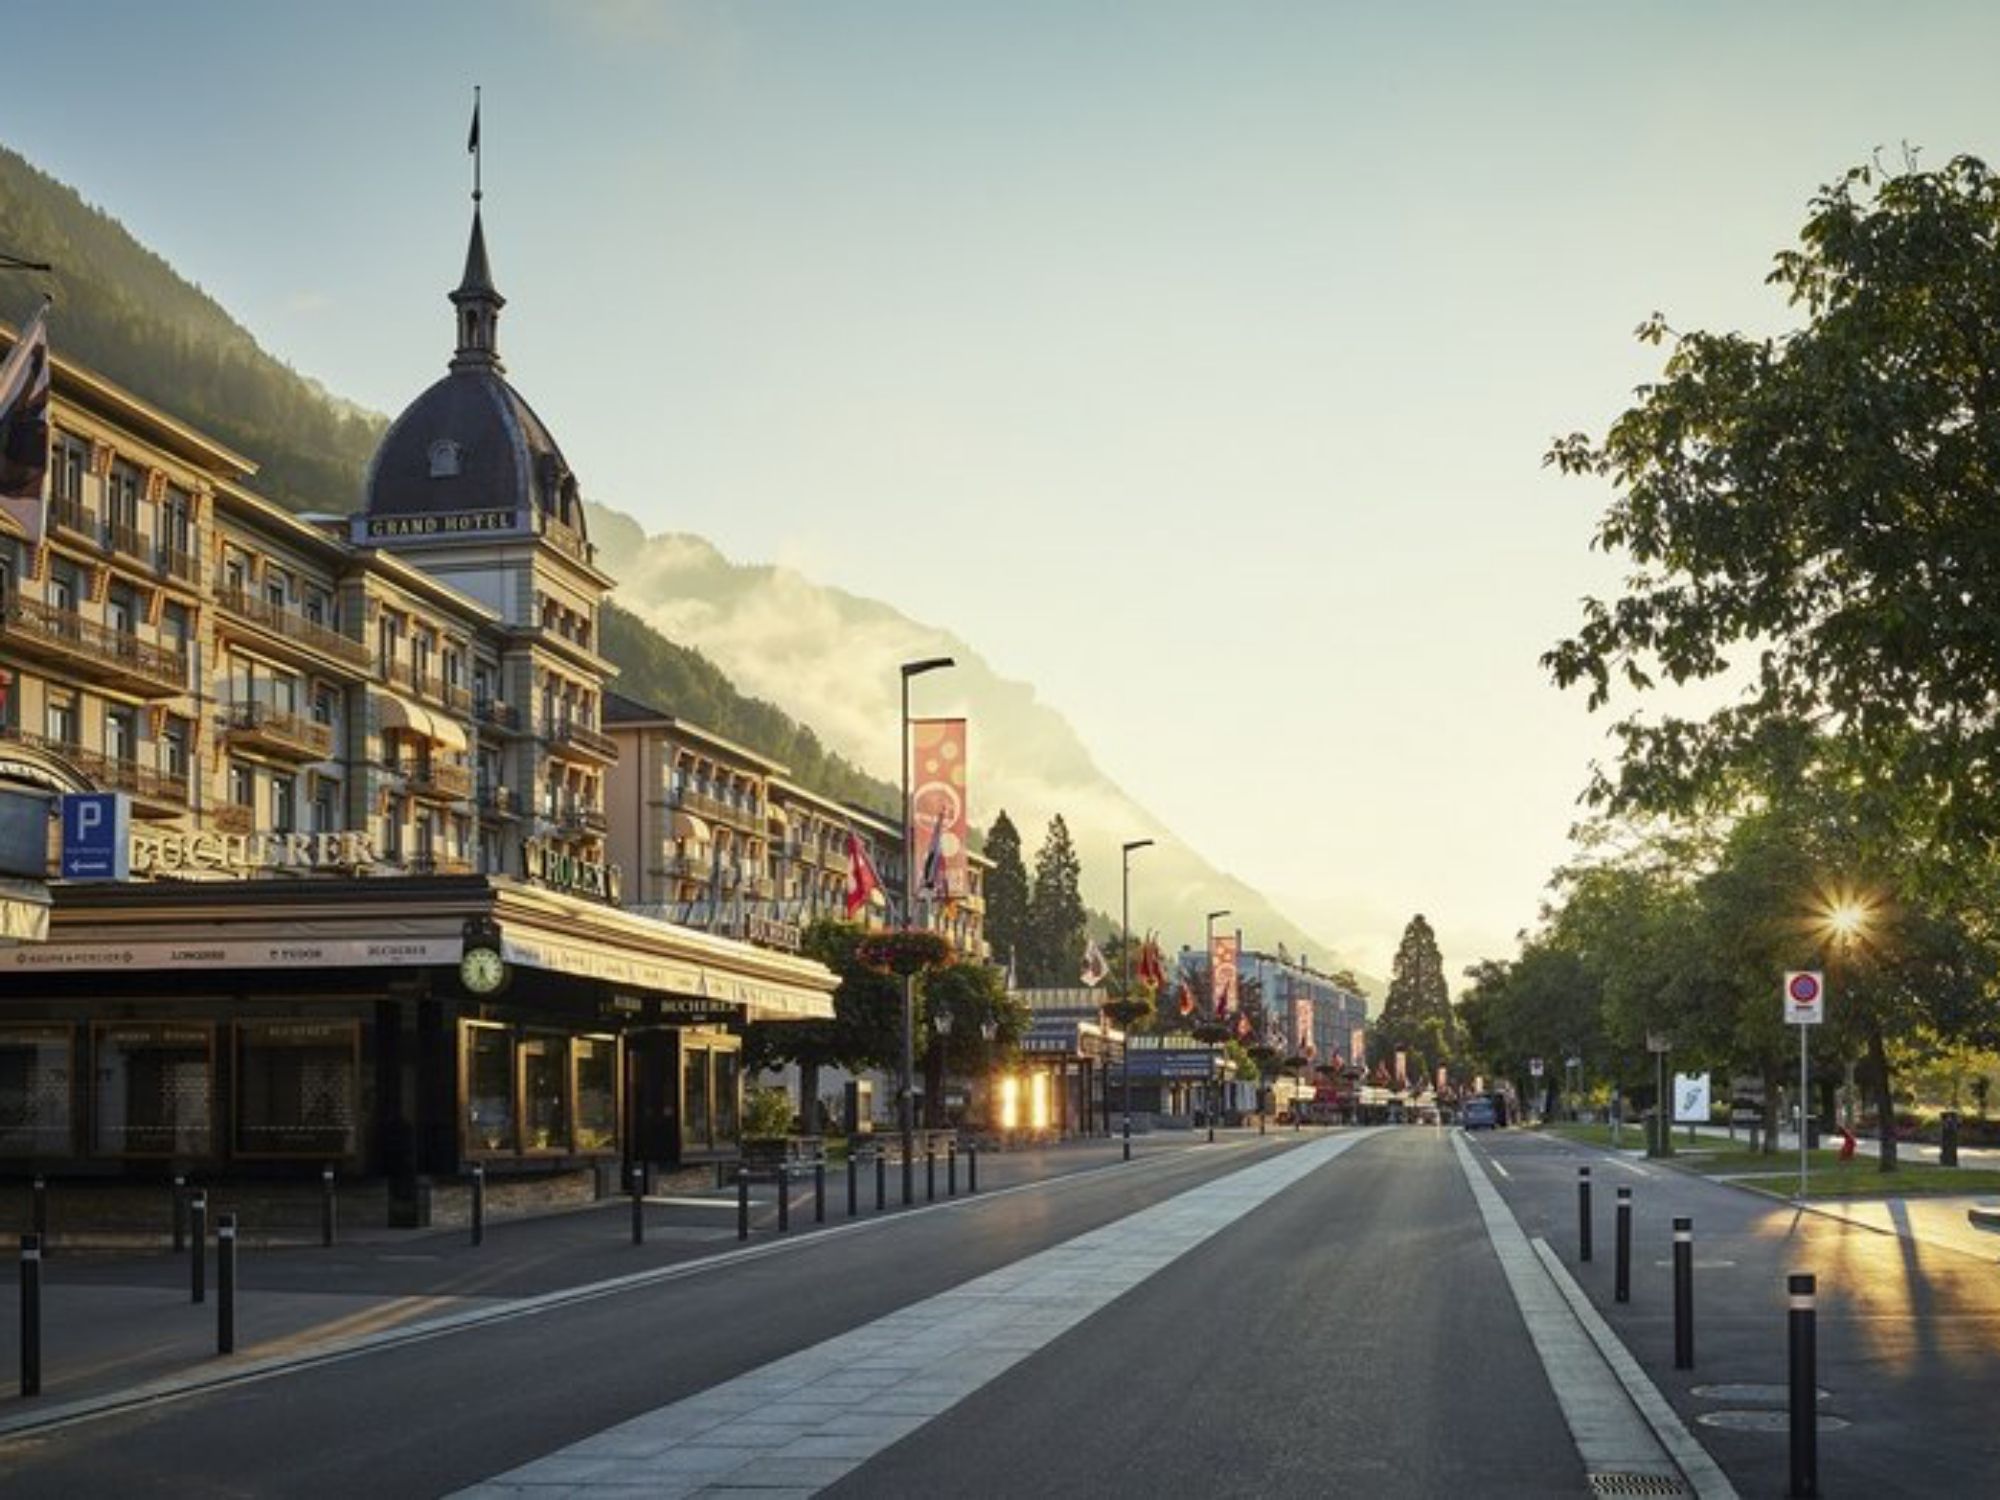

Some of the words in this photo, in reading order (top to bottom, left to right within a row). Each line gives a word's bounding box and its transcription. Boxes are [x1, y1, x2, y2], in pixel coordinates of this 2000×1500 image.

[372, 516, 437, 536] GRAND
[445, 513, 510, 530] HOTEL
[78, 801, 101, 841] P
[129, 832, 376, 869] BUCHERER
[545, 849, 606, 897] ROLEX
